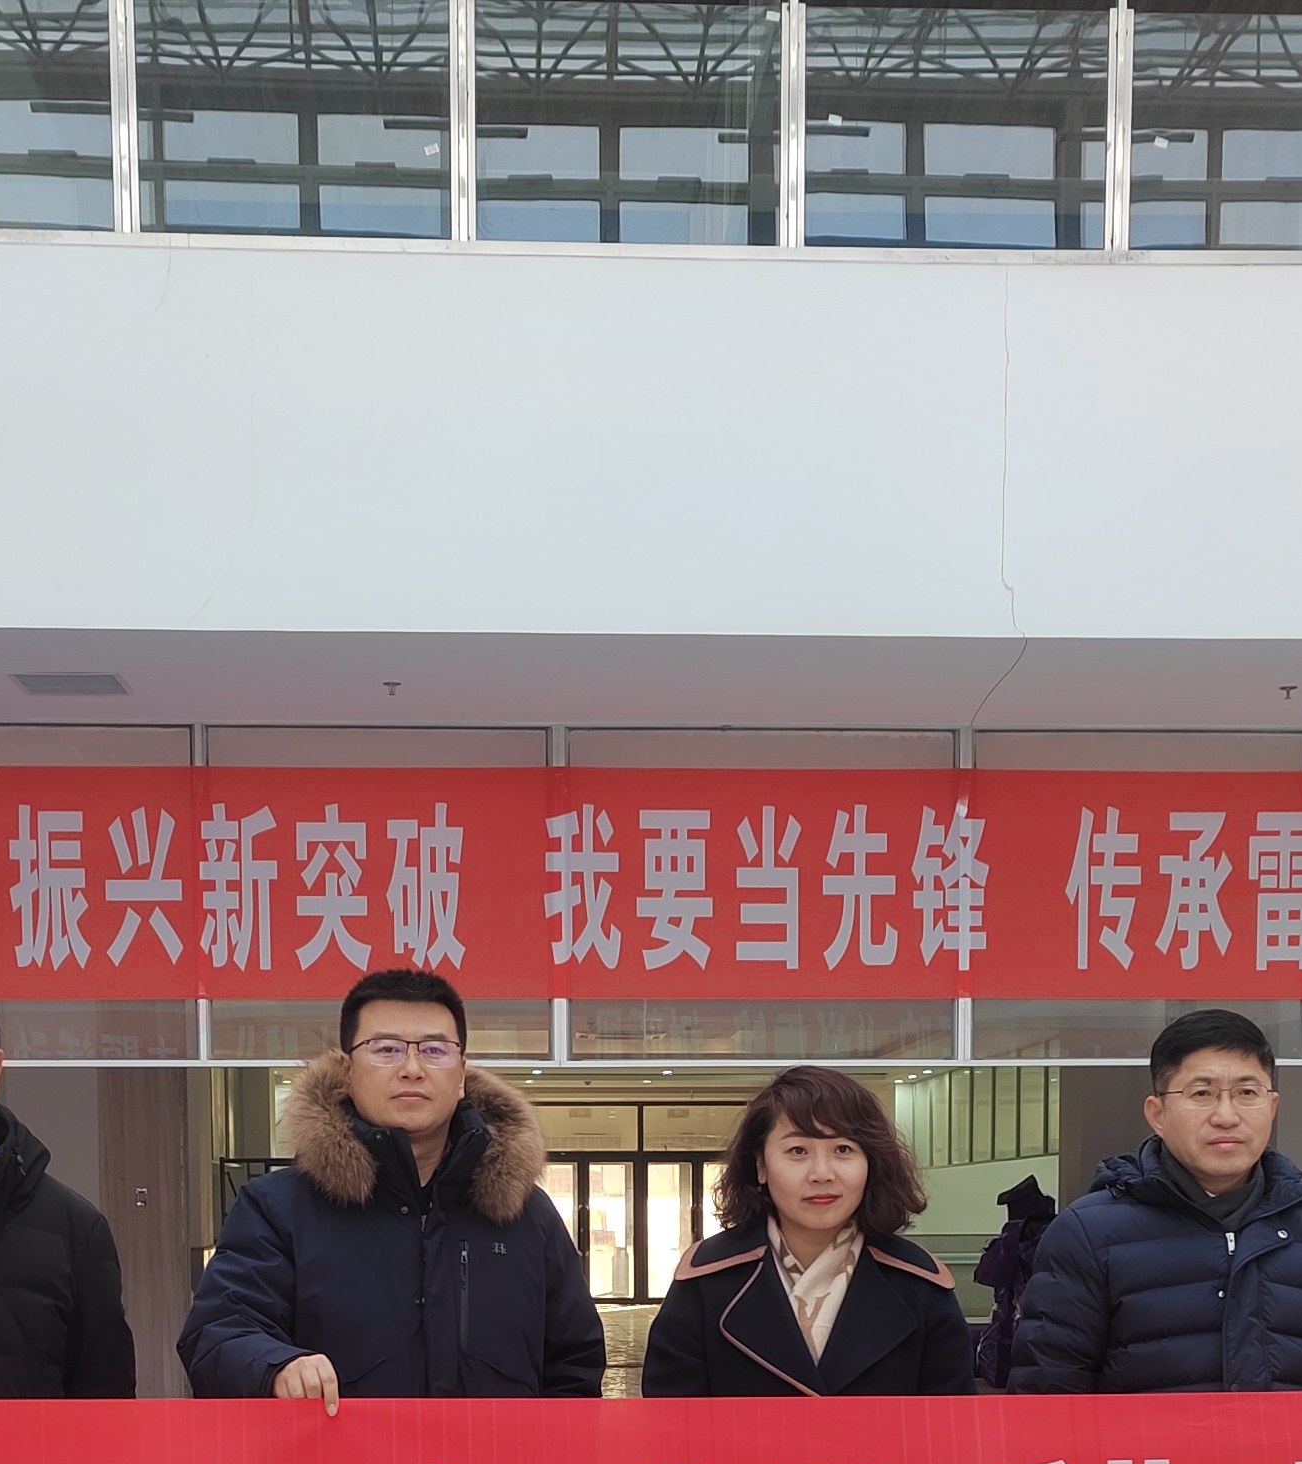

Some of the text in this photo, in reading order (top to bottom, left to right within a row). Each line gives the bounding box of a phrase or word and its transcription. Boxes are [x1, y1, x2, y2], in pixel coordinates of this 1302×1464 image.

[544, 803, 990, 971] 我要当先锋
